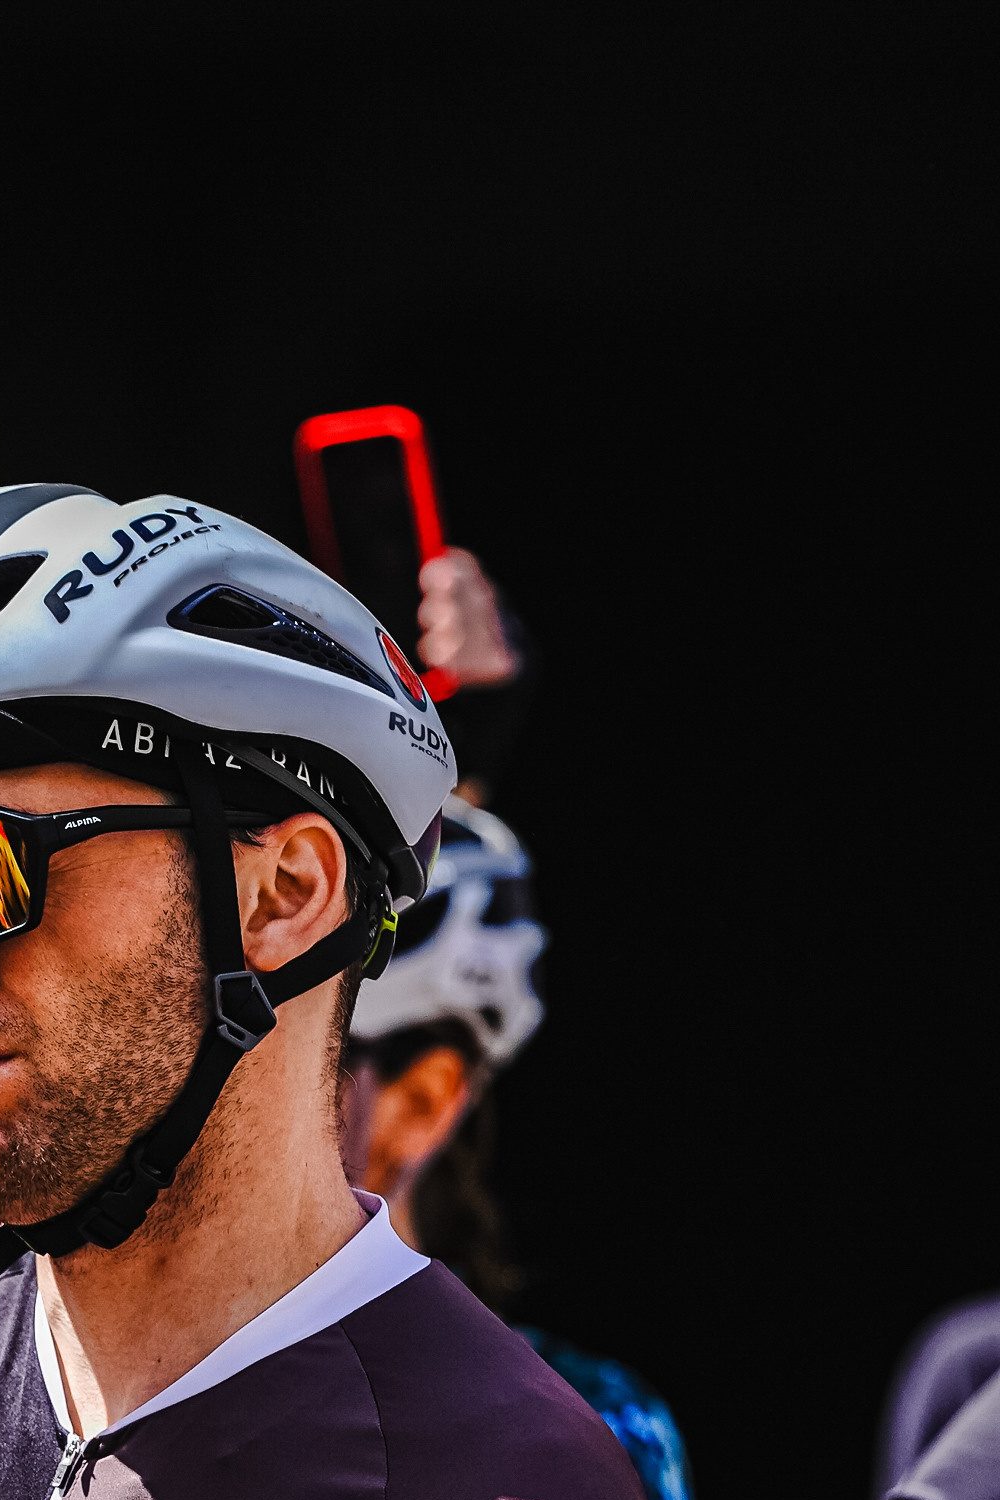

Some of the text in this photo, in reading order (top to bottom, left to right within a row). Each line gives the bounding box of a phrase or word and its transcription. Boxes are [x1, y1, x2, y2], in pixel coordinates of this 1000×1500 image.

[44, 506, 204, 624] RUDY
[113, 523, 221, 588] PROJECT
[388, 711, 448, 759] RUDY
[64, 816, 102, 830] ALPINA
